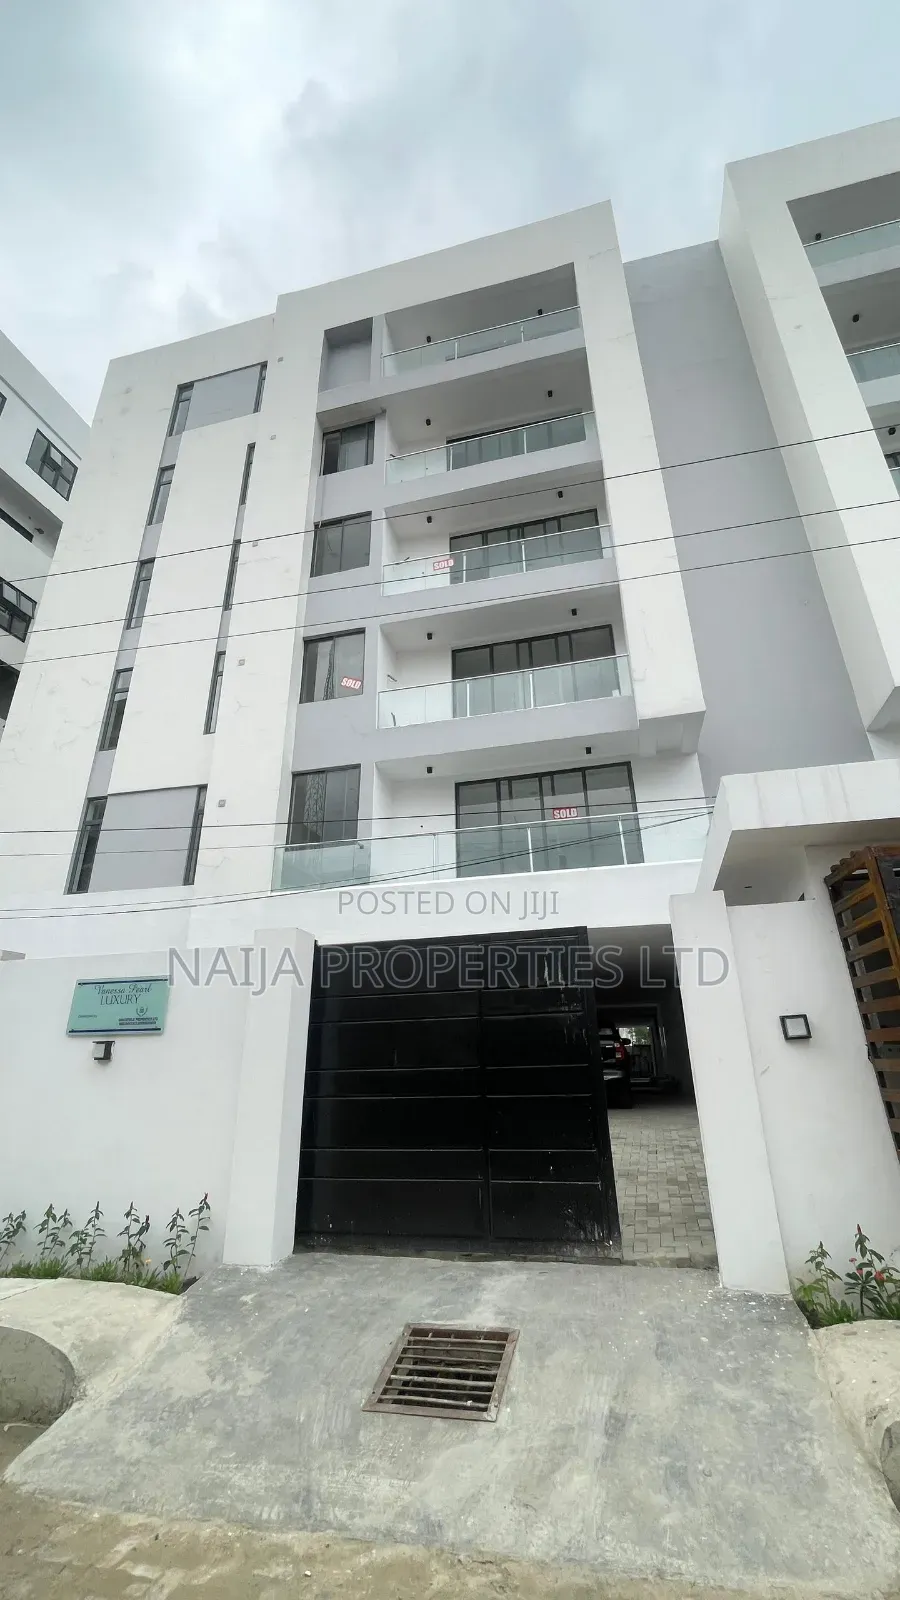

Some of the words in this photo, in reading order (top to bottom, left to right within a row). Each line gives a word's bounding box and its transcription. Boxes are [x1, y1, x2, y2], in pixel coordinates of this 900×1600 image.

[434, 559, 454, 570] SOLD
[341, 677, 362, 690] SOLD
[554, 808, 578, 819] SOLD
[94, 985, 126, 995] Vanessa
[128, 983, 153, 994] Pearl
[100, 994, 142, 1006] LUXURY
